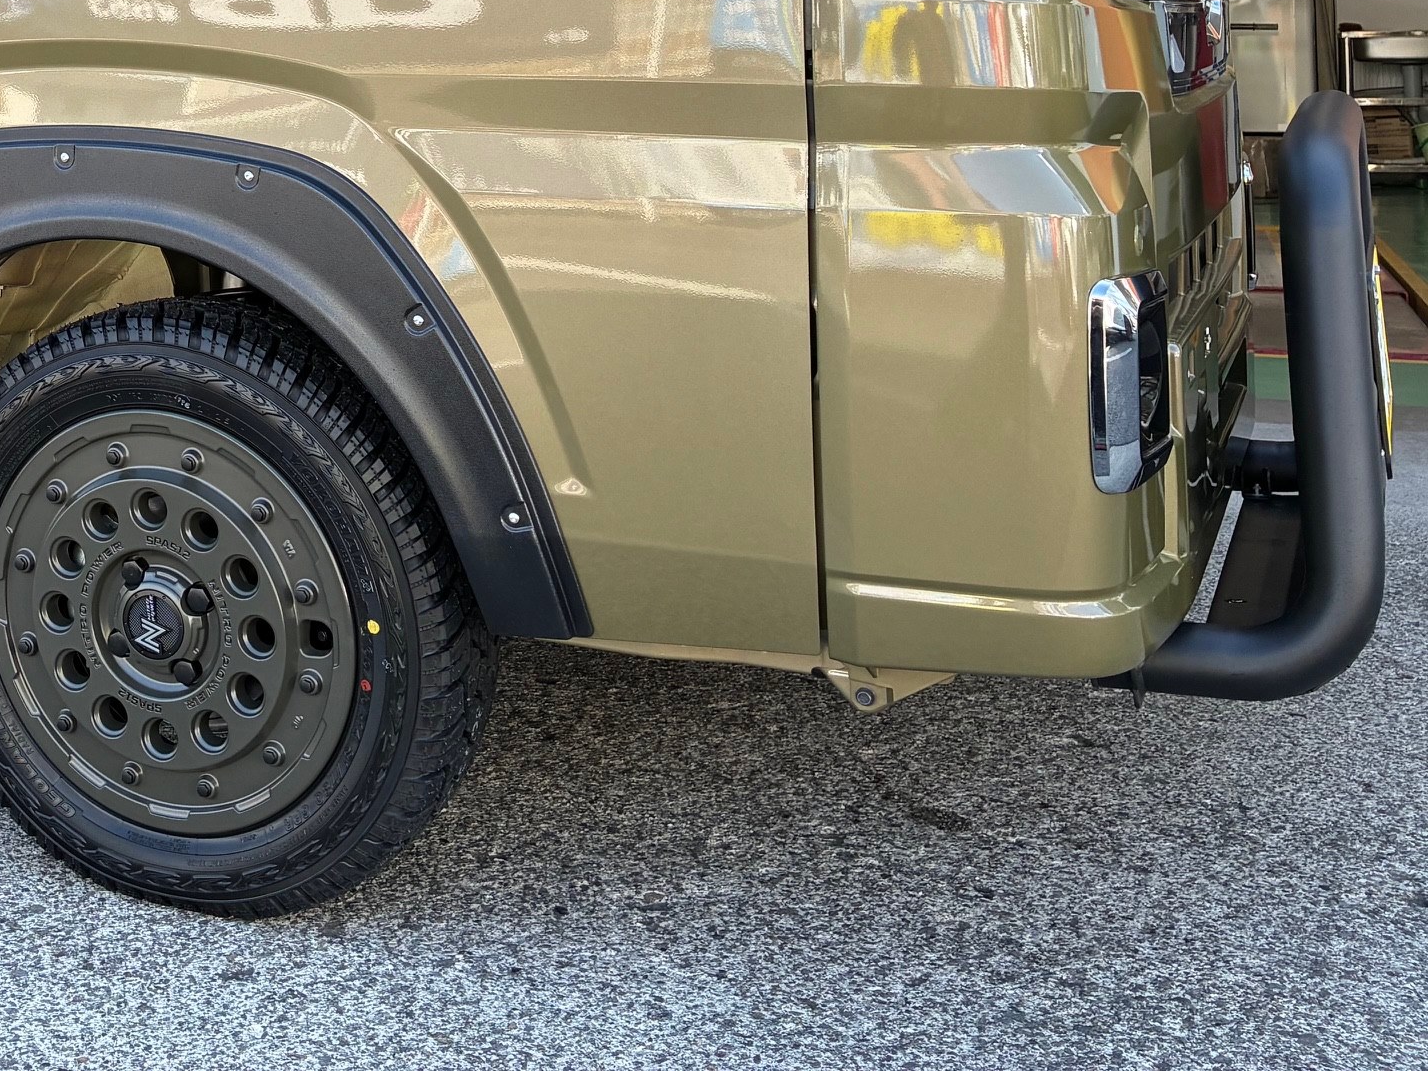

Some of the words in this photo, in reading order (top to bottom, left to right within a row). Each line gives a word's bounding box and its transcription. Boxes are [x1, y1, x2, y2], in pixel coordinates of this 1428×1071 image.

[145, 535, 191, 561] SPAS12
[288, 449, 375, 594] YOKOHAM
[81, 541, 124, 597] POWER
[117, 687, 163, 714] SPAS12
[186, 654, 231, 710] POWER
